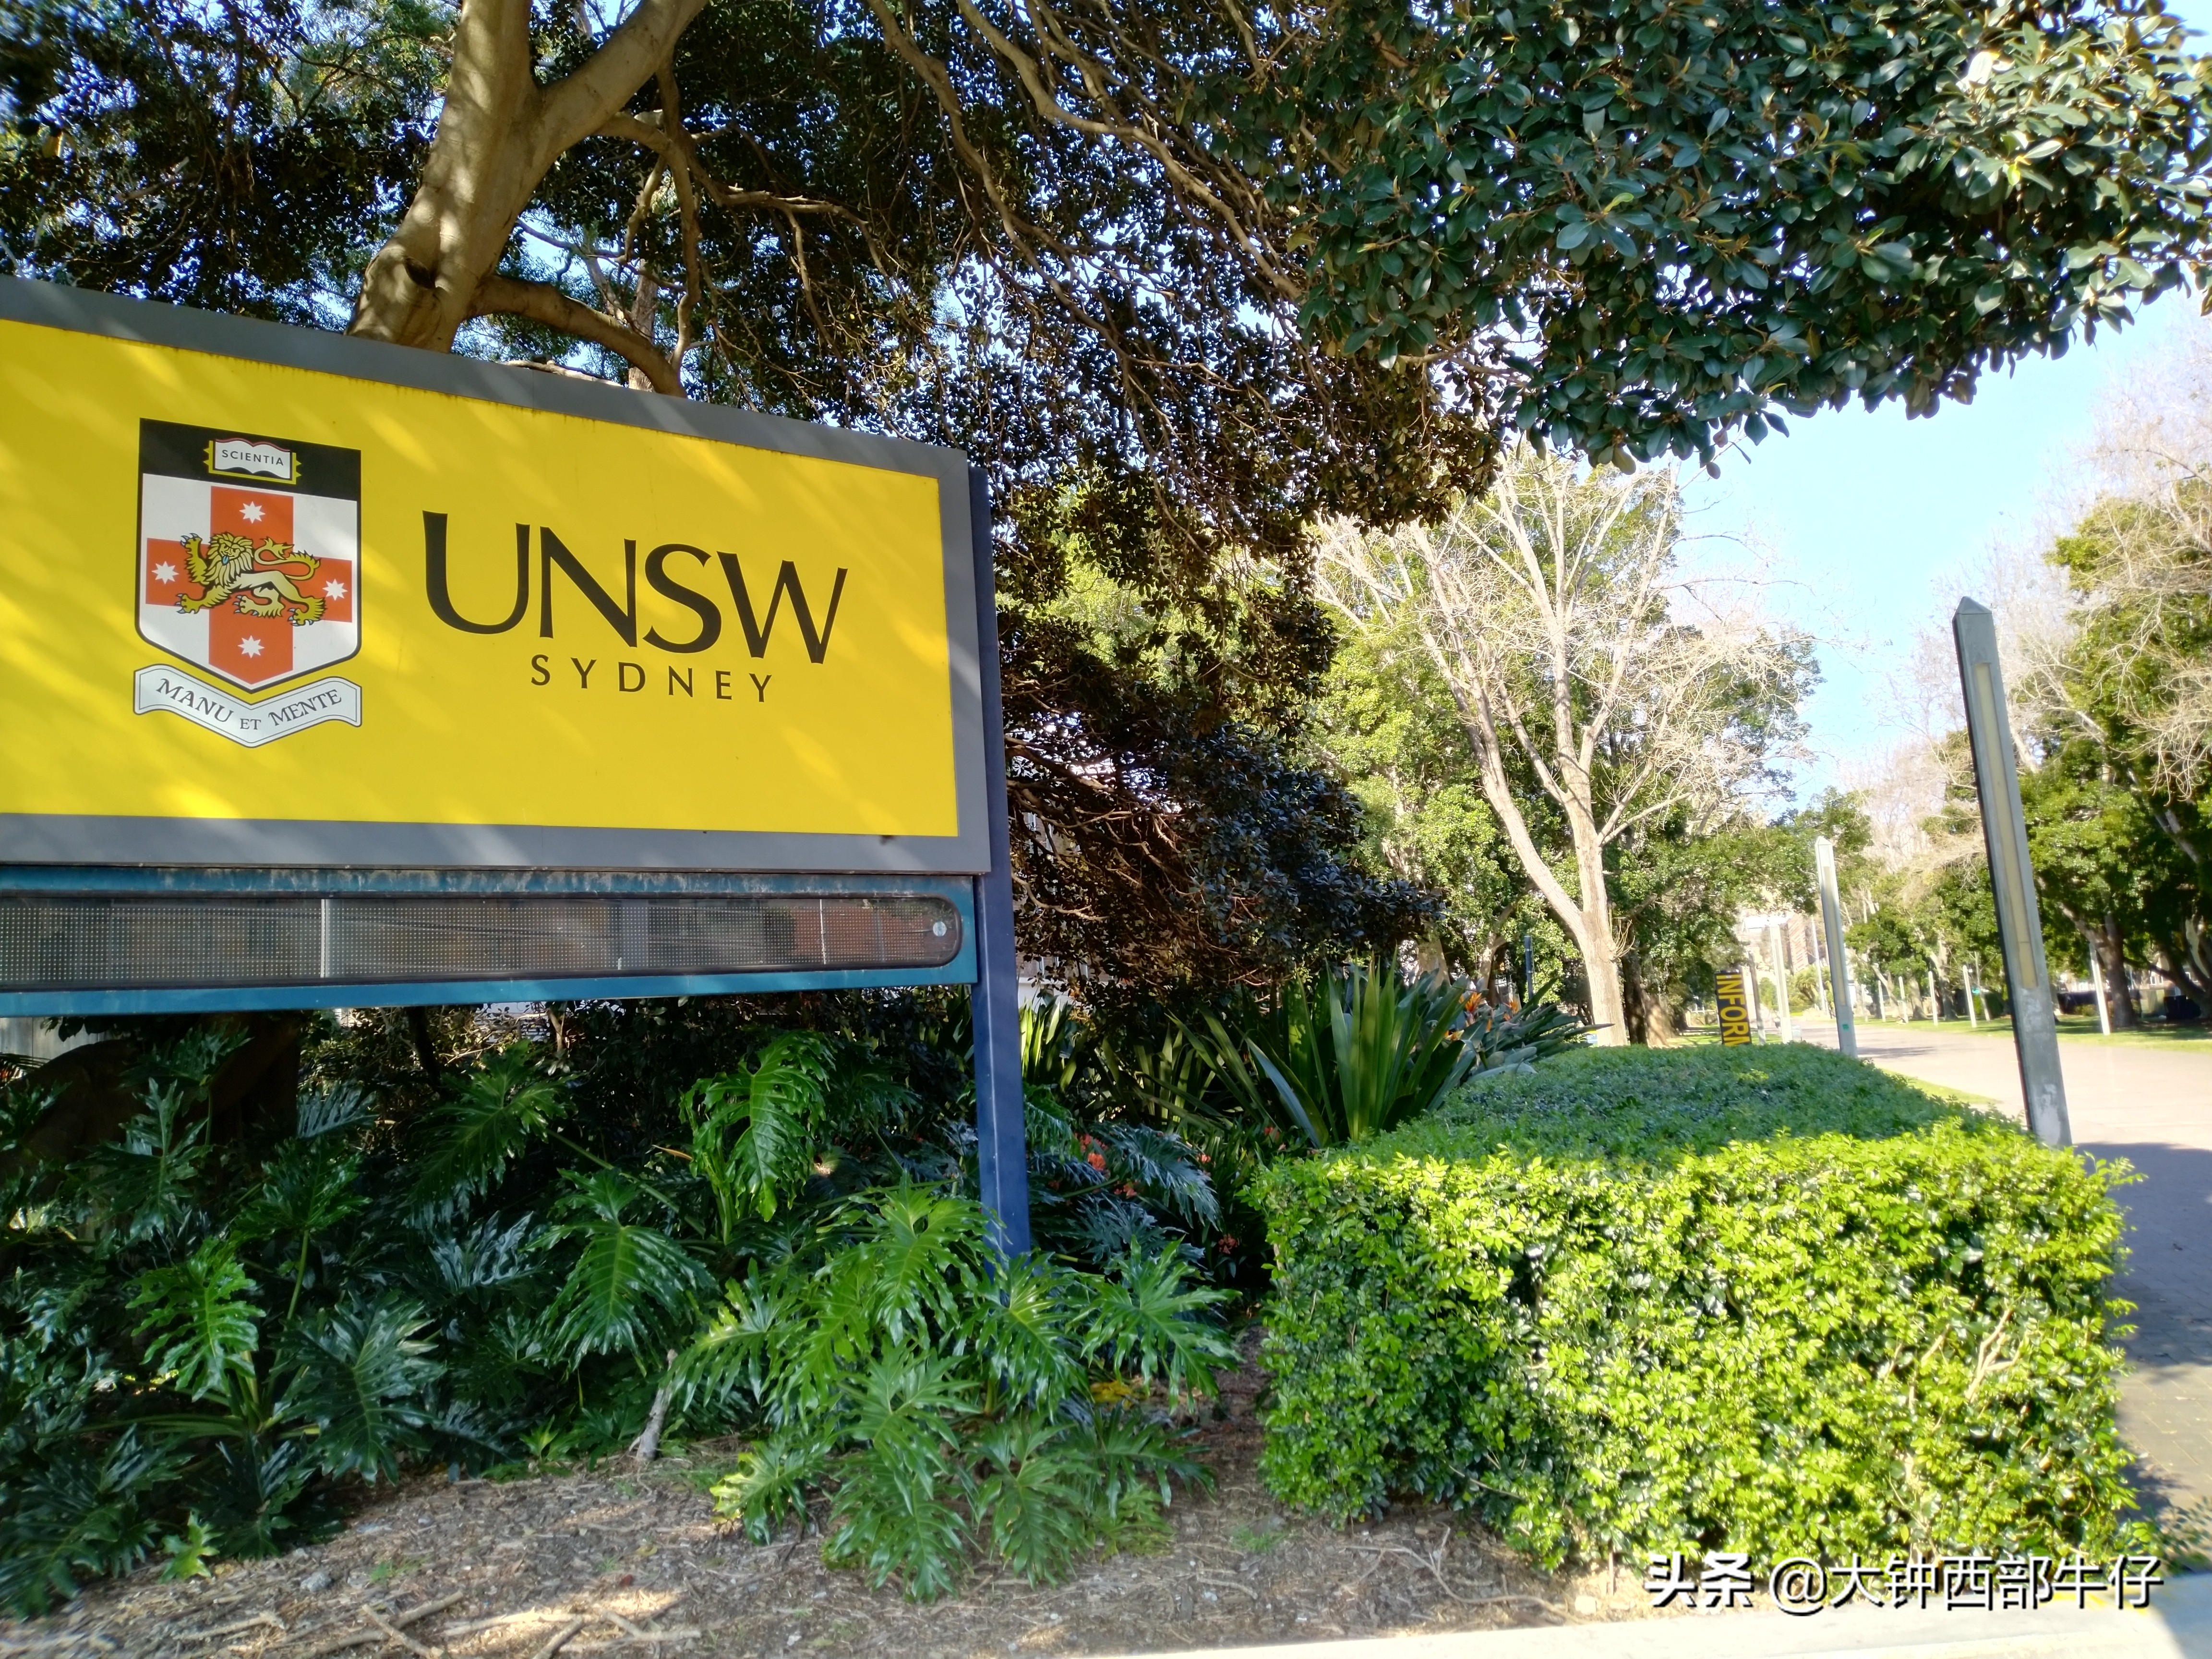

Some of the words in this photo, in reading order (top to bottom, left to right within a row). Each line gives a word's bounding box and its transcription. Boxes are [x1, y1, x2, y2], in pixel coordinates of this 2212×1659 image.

[222, 449, 284, 466] SCIENTIA
[422, 510, 848, 664] UNSW
[530, 654, 772, 703] SYDNEY
[156, 678, 234, 723] MANU
[240, 718, 261, 731] ET
[268, 688, 342, 726] MENTE
